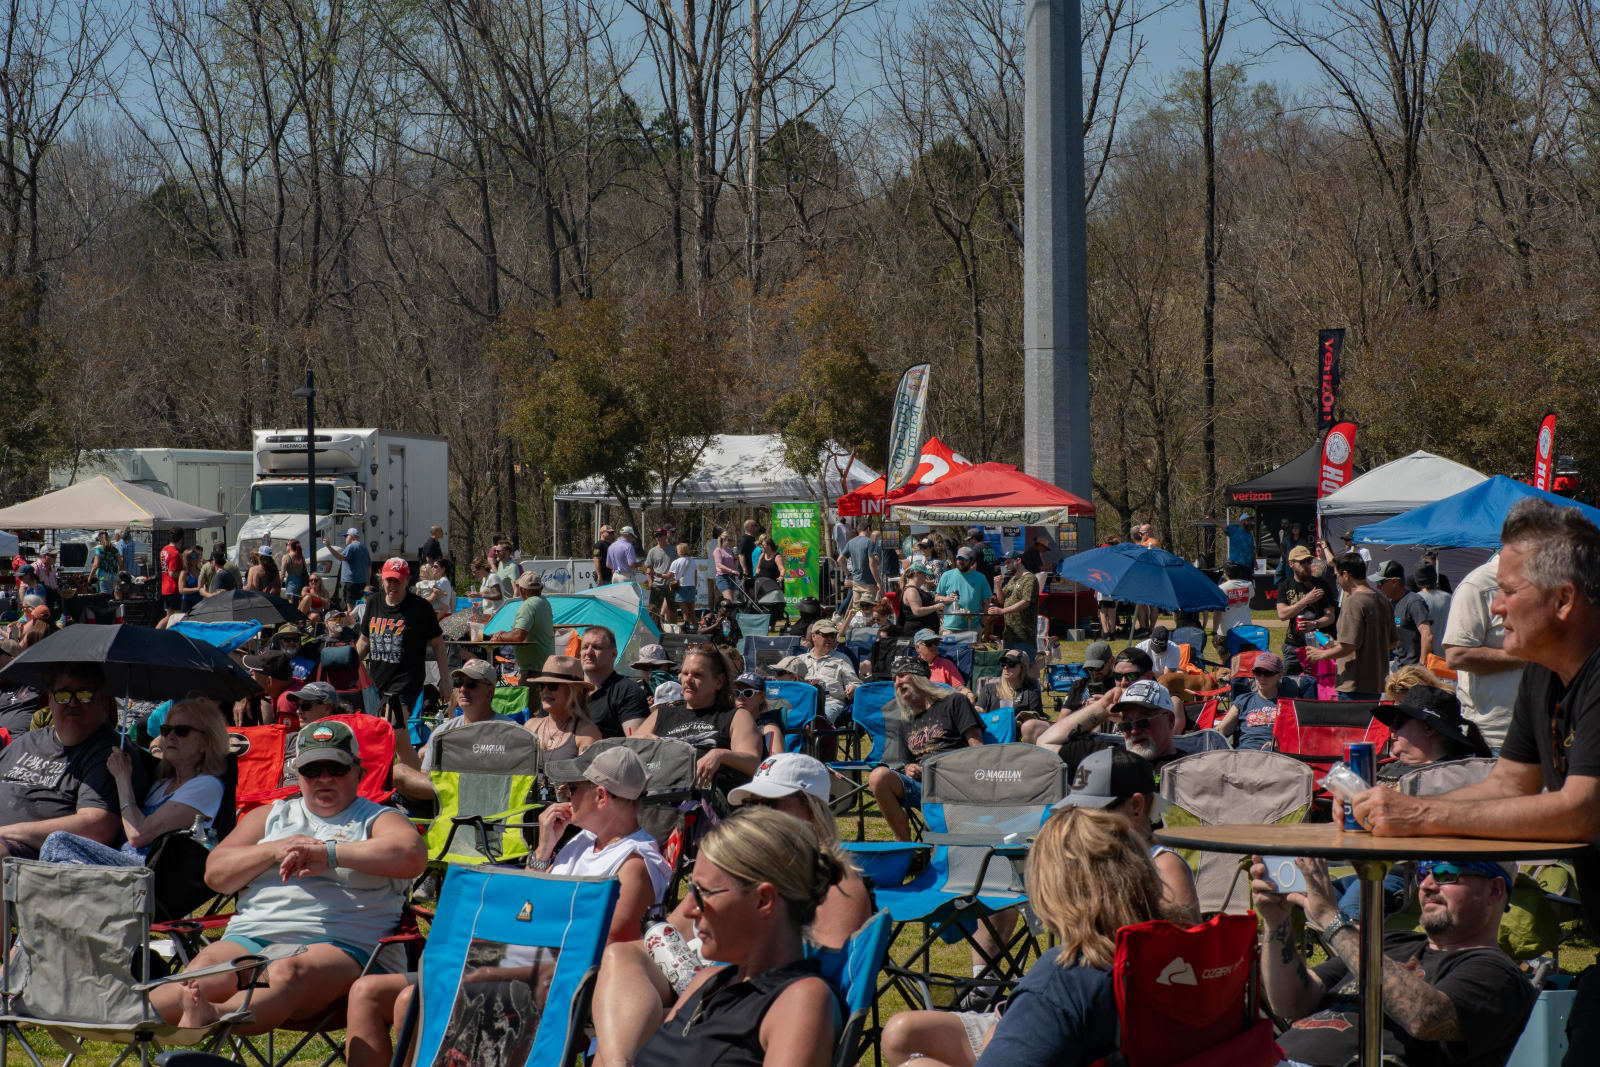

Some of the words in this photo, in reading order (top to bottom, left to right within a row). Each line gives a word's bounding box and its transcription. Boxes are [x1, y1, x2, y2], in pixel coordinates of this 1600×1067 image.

[1321, 338, 1335, 421] verizon
[894, 392, 910, 470] Shake-Up
[908, 405, 920, 458] Lemon
[1232, 490, 1272, 501] verizon
[780, 518, 811, 528] SOUR
[918, 509, 967, 522] Lemon
[968, 509, 1041, 524] Shake-Up
[986, 769, 1022, 779] MAGELLAN
[1202, 966, 1232, 979] OZARK
